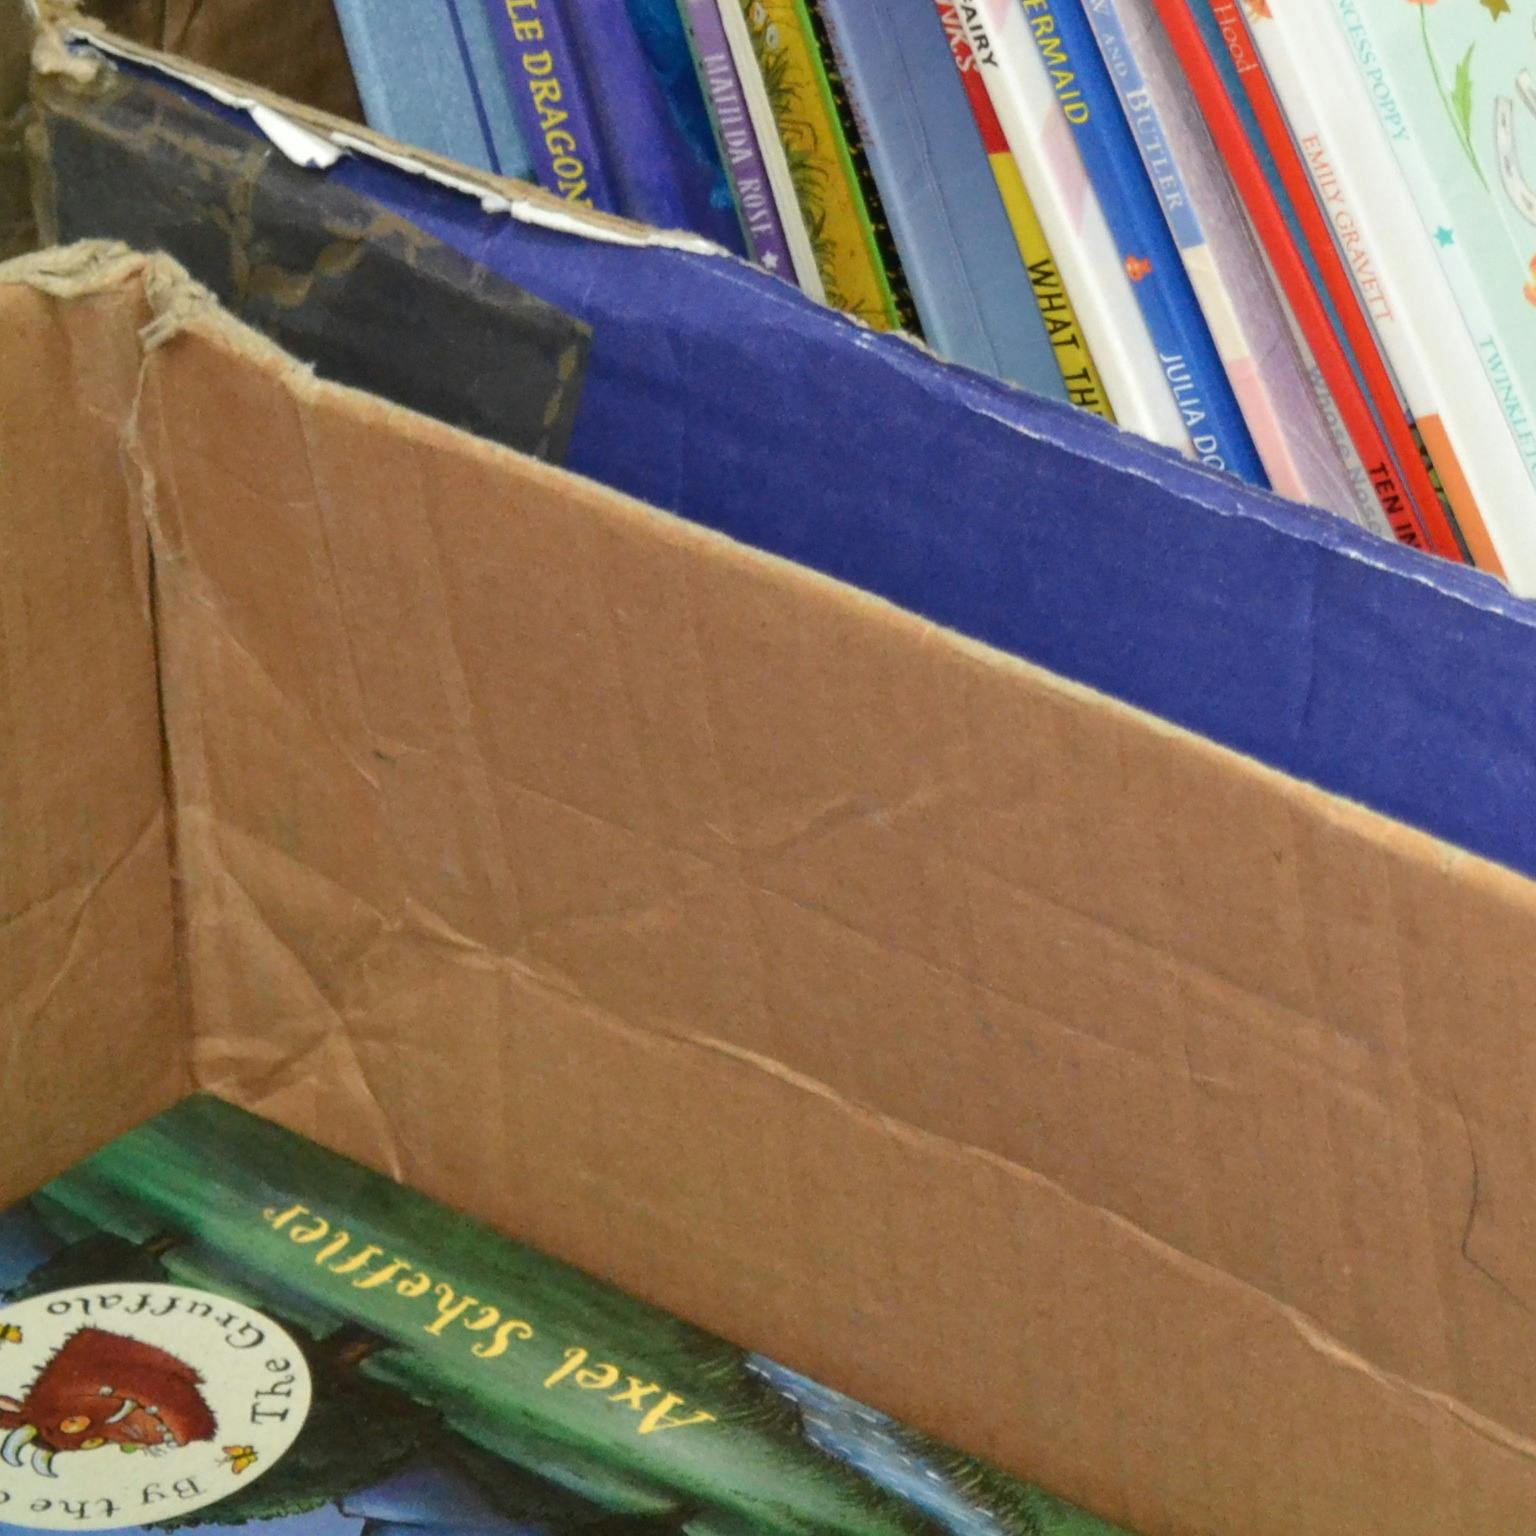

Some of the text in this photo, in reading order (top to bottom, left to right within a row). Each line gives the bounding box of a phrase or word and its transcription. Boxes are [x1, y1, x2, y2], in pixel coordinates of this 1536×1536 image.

[1214, 4, 1257, 74] Hood
[524, 54, 594, 211] DRAGON
[1102, 33, 1128, 77] AND
[1127, 90, 1184, 212] BUTLER
[1363, 65, 1409, 142] POPPY
[739, 175, 772, 239] ROSE
[1301, 134, 1394, 324] EMILY GRAVETT
[1028, 259, 1104, 419] WHAT TH
[1160, 353, 1206, 427] JULIA
[1370, 462, 1403, 513] TEN
[264, 1204, 716, 1436] Axel Scheffler
[47, 1292, 294, 1426] The Gruffalo
[29, 1498, 121, 1520] the
[140, 1475, 208, 1506] By
